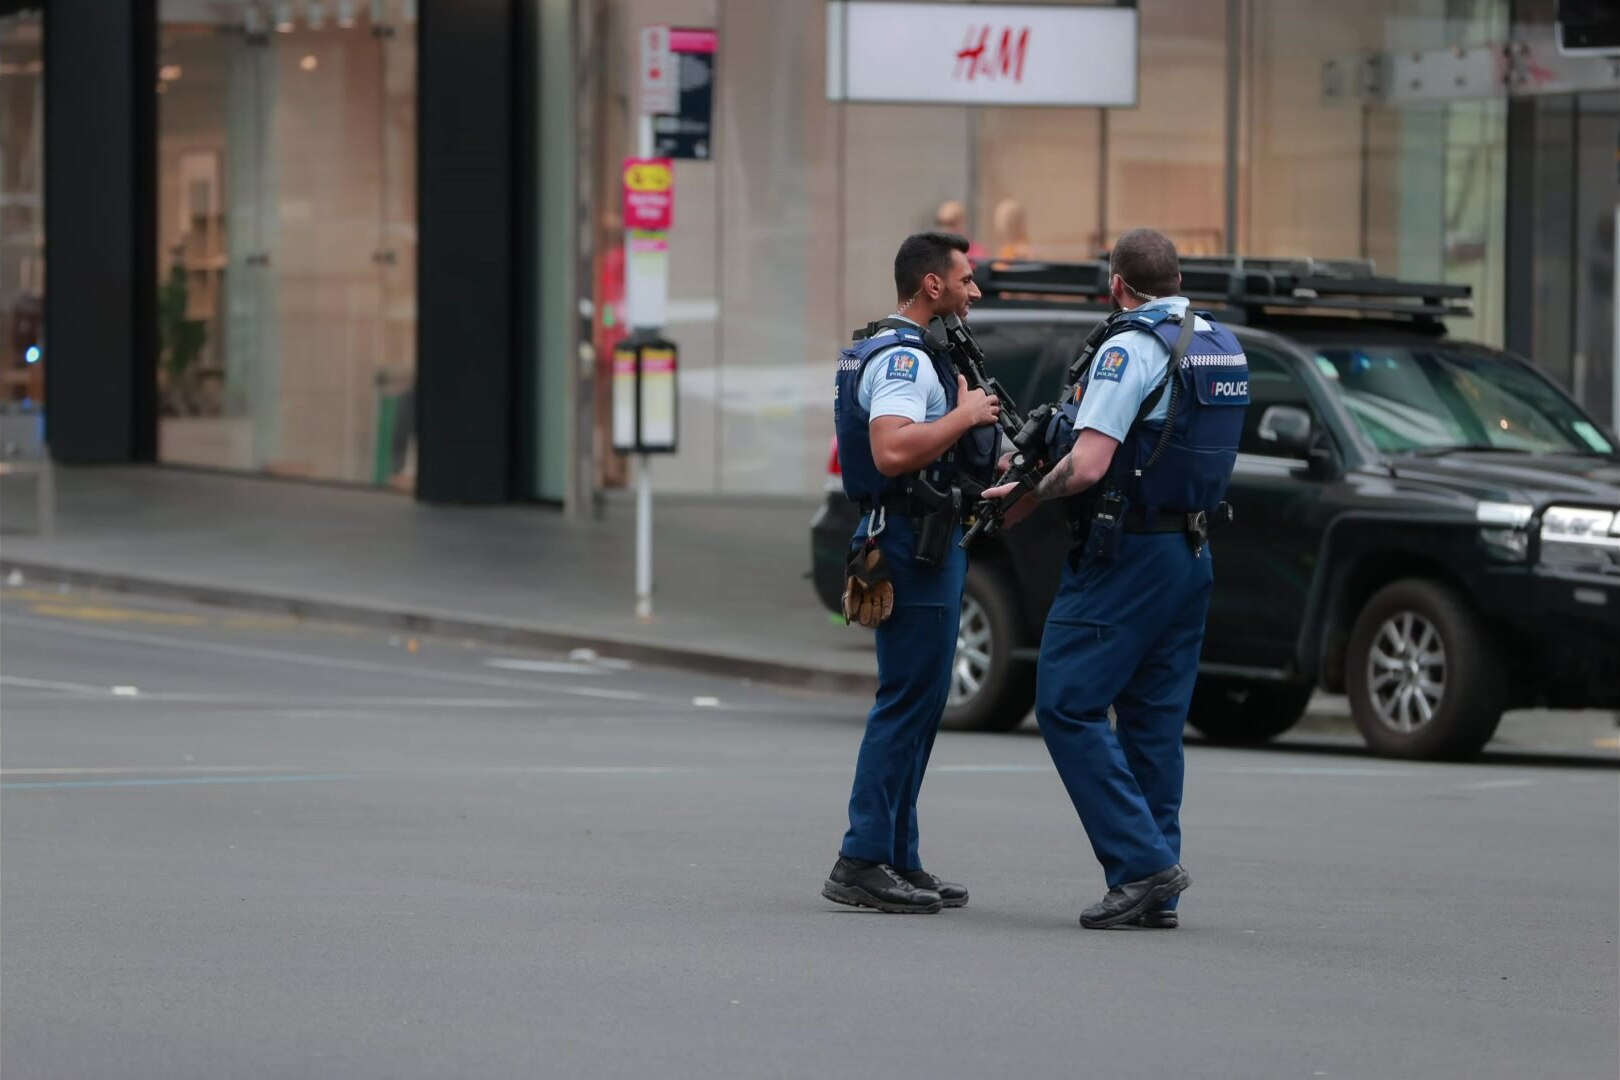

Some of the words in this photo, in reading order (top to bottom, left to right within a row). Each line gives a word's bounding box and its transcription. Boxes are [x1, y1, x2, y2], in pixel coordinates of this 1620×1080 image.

[890, 371, 913, 379] POLICE
[1097, 371, 1119, 379] POLICE
[1215, 381, 1248, 396] POLICE
